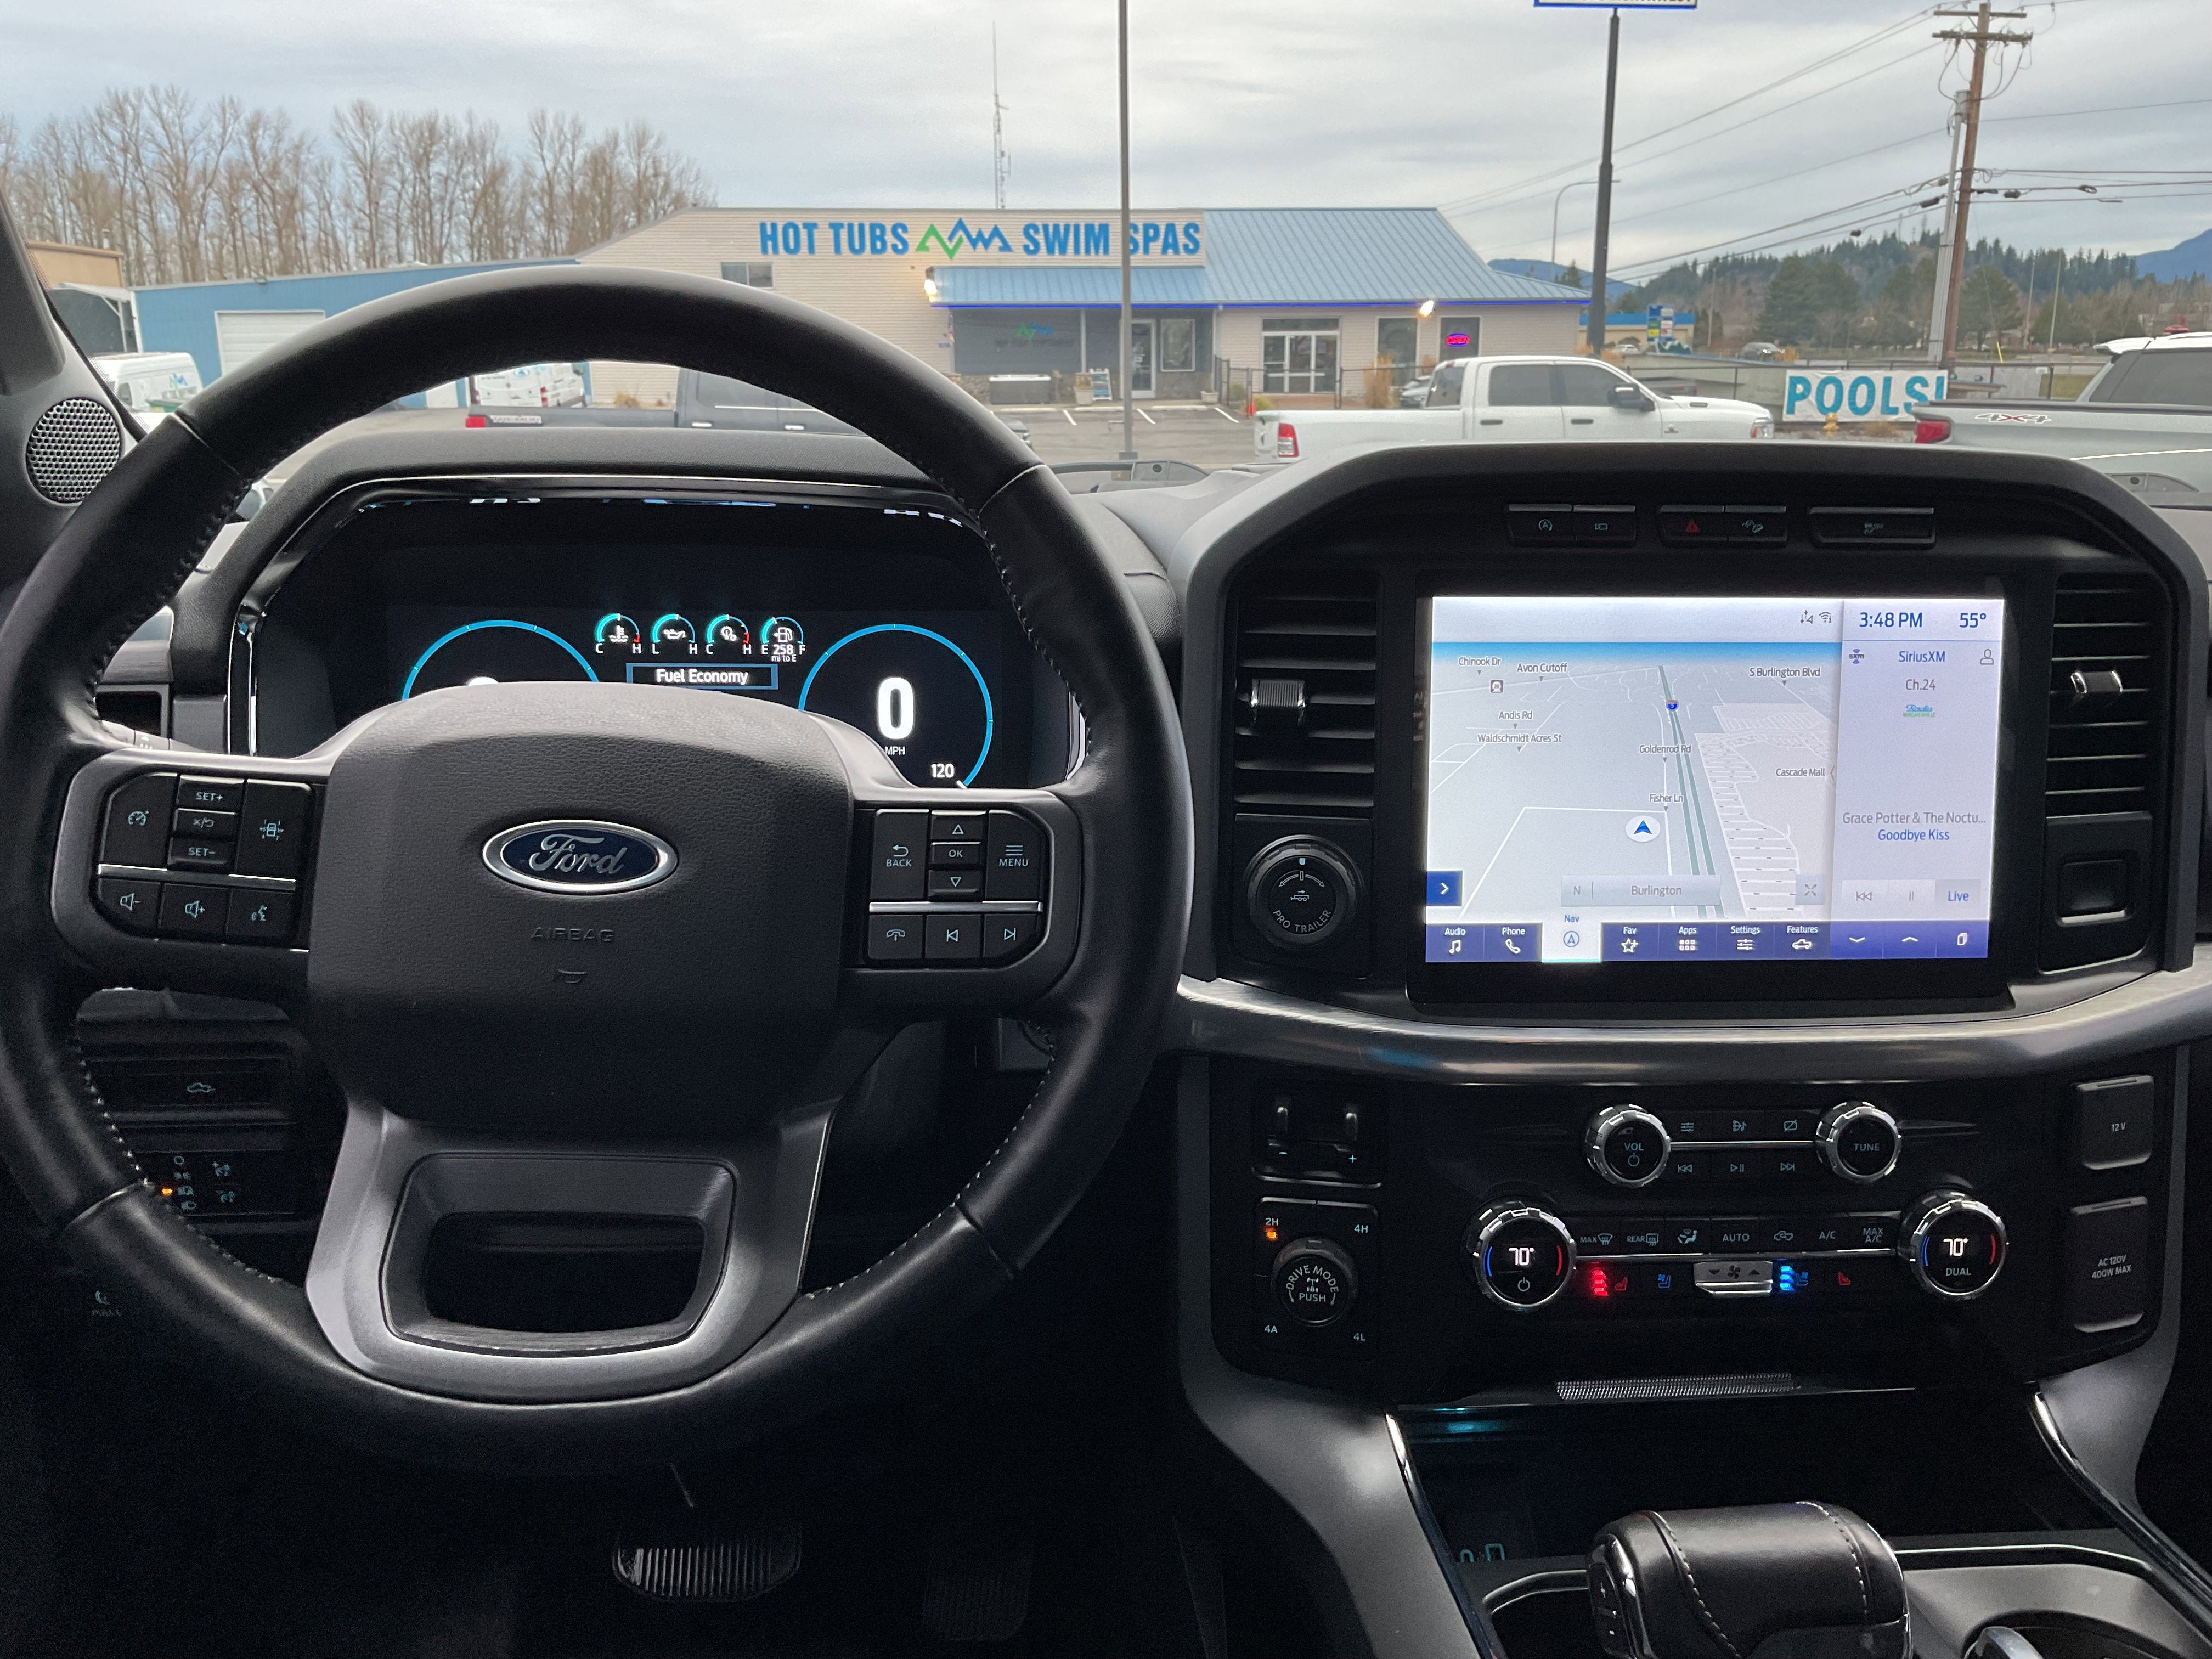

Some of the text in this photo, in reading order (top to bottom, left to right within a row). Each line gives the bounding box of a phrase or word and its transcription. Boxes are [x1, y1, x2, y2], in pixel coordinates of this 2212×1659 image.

[759, 222, 909, 255] HOT TUBS
[1023, 222, 1200, 256] SWIM SPAS
[1859, 612, 1923, 628] 3:48 PM
[1959, 612, 1987, 628] 55°
[595, 644, 603, 653] C
[632, 644, 642, 654] H
[652, 645, 659, 654] L
[689, 644, 698, 654] H
[706, 644, 714, 654] C
[743, 644, 752, 655] H
[761, 645, 769, 655] E
[773, 644, 794, 655] 258
[799, 644, 806, 655] F
[782, 654, 791, 662] to
[1458, 656, 1501, 667] Chinook Dr
[1898, 651, 1946, 663] SiriusXM
[1517, 662, 1567, 673] Avon Cutoff
[1749, 667, 1821, 678] S Burlington Blvd
[657, 669, 748, 685] Fuel Economy
[1905, 679, 1936, 691] Ch.24
[878, 676, 915, 740] 0
[1499, 710, 1533, 720] Andis Rd
[1477, 733, 1562, 743] Waldschmidt Acres St
[885, 746, 905, 755] MPH
[1639, 744, 1691, 754] Goldenrod Rd
[931, 763, 955, 778] 120
[1775, 768, 1825, 777] Cascade Mall
[1649, 794, 1684, 803] Fisher Ln
[1843, 812, 1874, 824] Grace
[1875, 812, 1910, 824] Potter
[1912, 813, 1921, 824] &
[1923, 812, 1945, 824] The
[1878, 830, 1950, 842] Goodbye Kiss
[529, 833, 628, 874] Ford
[949, 849, 963, 858] OK
[885, 859, 912, 867] BACK
[998, 859, 1029, 867] MENU
[1573, 885, 1682, 899] N Burlington
[1948, 890, 1969, 901] Live
[1273, 910, 1331, 933] PRO TRAILER
[1564, 915, 1580, 923] Nav
[531, 927, 615, 942] AIRBAG
[1444, 927, 1466, 936] Audio
[1502, 927, 1525, 936] Phone
[1679, 927, 1697, 936] Apps
[1730, 926, 1760, 935] Settings
[1787, 926, 1818, 934] Features
[1624, 1143, 1644, 1152] VOL
[1854, 1143, 1880, 1152] TUNE
[1265, 1217, 1279, 1227] 2H
[1354, 1225, 1369, 1233] 4H
[1722, 1233, 1750, 1242] AUTO
[1819, 1231, 1836, 1240] A/C
[1865, 1234, 1882, 1243] A/C
[2097, 1254, 2127, 1267] AC 120V
[1945, 1267, 1971, 1276] DUAL
[2091, 1264, 2131, 1279] 400W MAX
[1285, 1265, 1339, 1293] DRIVE MODE
[1299, 1293, 1327, 1302] PUSH
[1264, 1325, 1278, 1334] 4A
[1353, 1333, 1366, 1341] 4L
